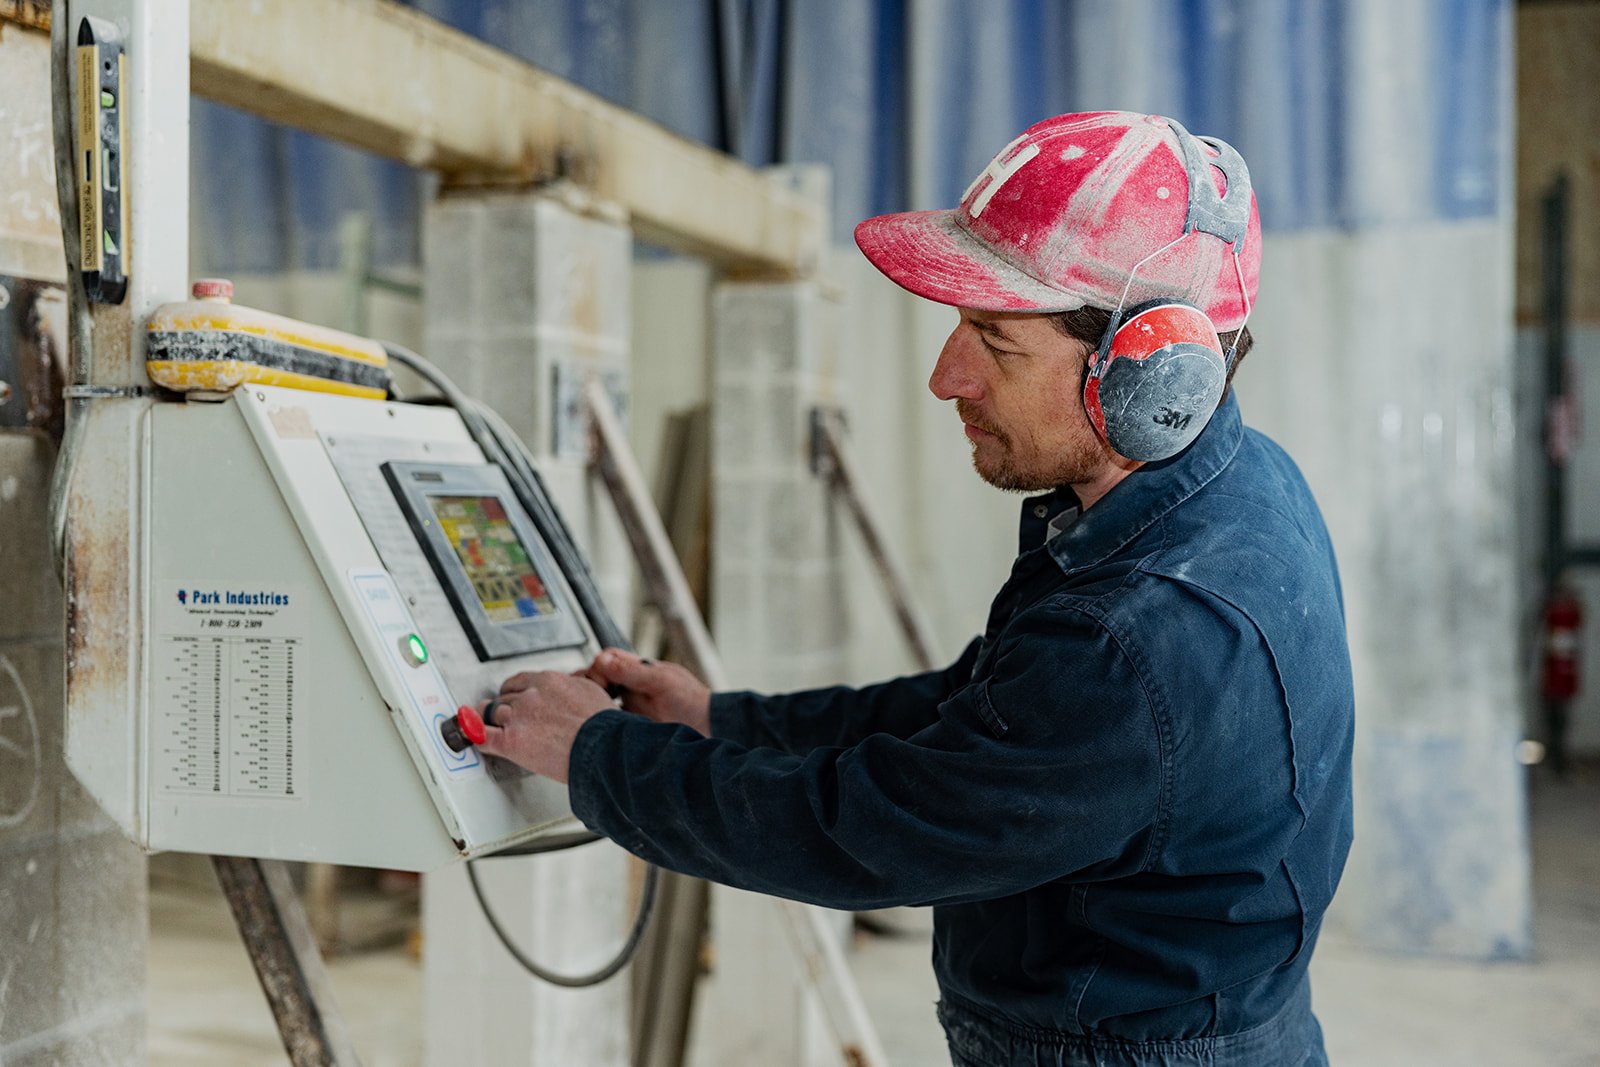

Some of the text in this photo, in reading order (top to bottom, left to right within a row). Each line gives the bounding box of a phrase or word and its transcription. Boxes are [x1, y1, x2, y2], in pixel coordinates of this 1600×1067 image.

[961, 133, 1040, 219] H
[1152, 406, 1193, 430] 3M
[193, 590, 289, 605] Park Industries
